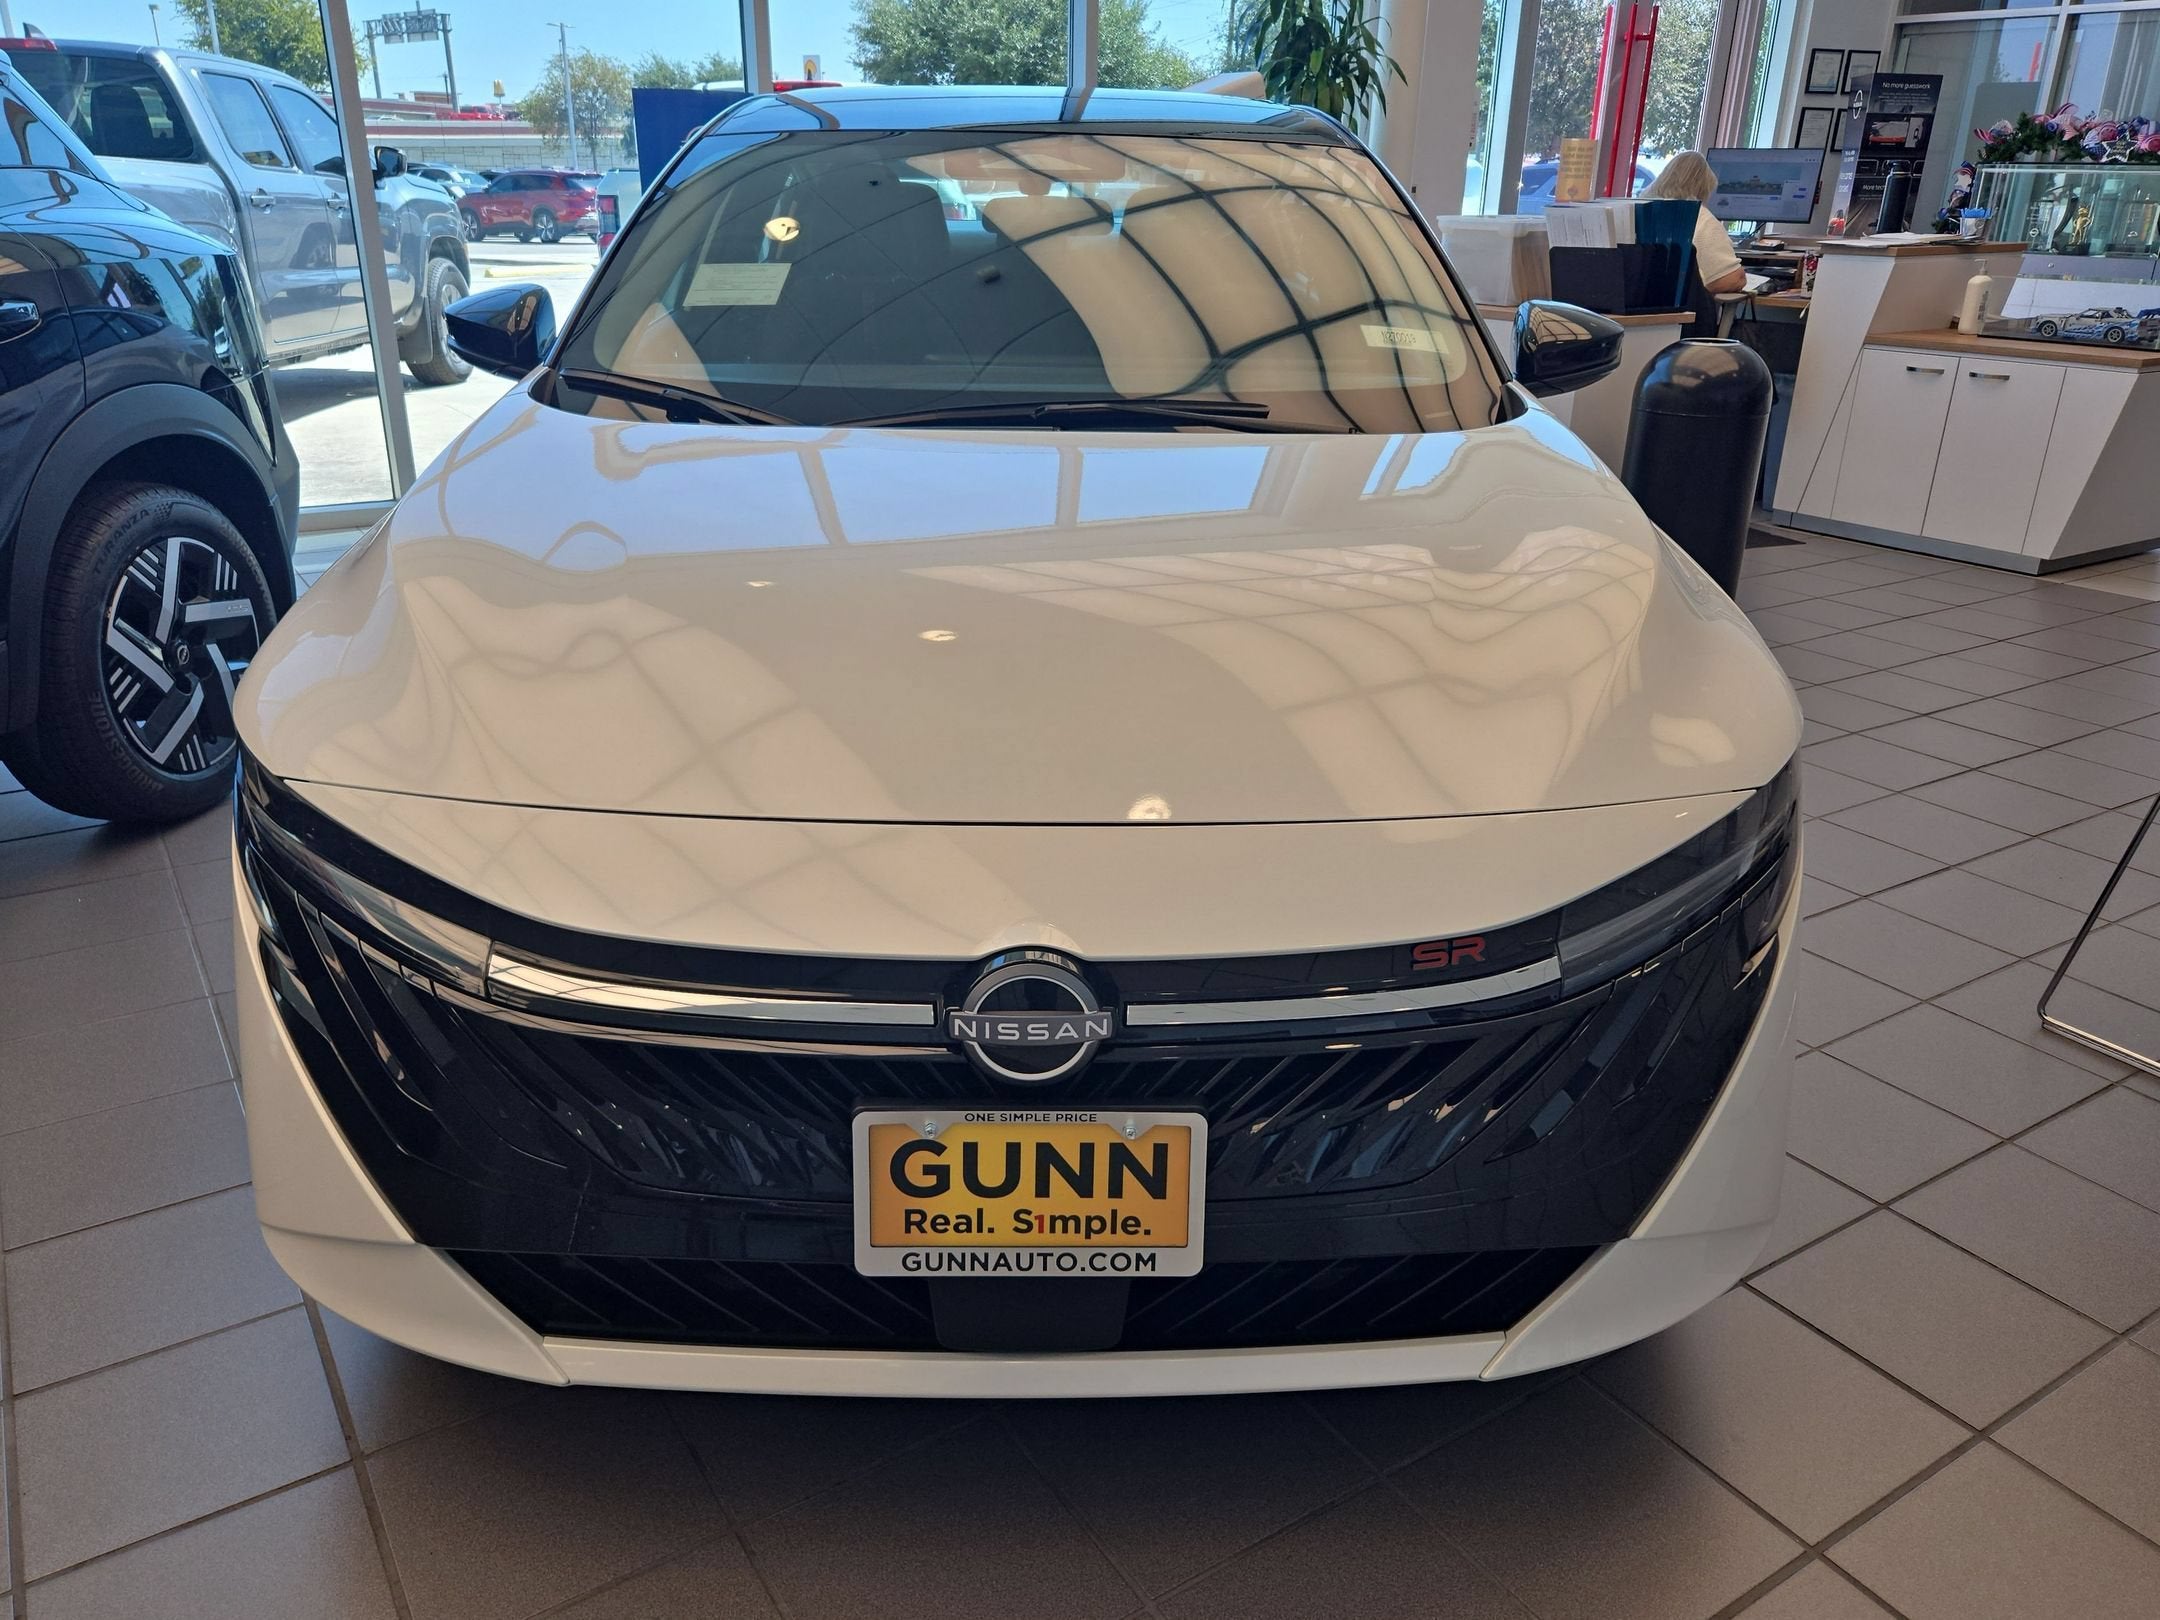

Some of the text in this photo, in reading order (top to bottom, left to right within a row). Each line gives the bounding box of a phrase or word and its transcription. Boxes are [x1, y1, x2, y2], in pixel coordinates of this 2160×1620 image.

[1412, 936, 1486, 971] SR
[954, 1018, 1108, 1041] NISSAN
[964, 1113, 1097, 1123] ONE SIMPLE PRICE
[889, 1139, 1169, 1200] GUNN
[904, 1208, 995, 1235] Real.
[901, 1252, 1157, 1273] GUNNAUTO.COM
